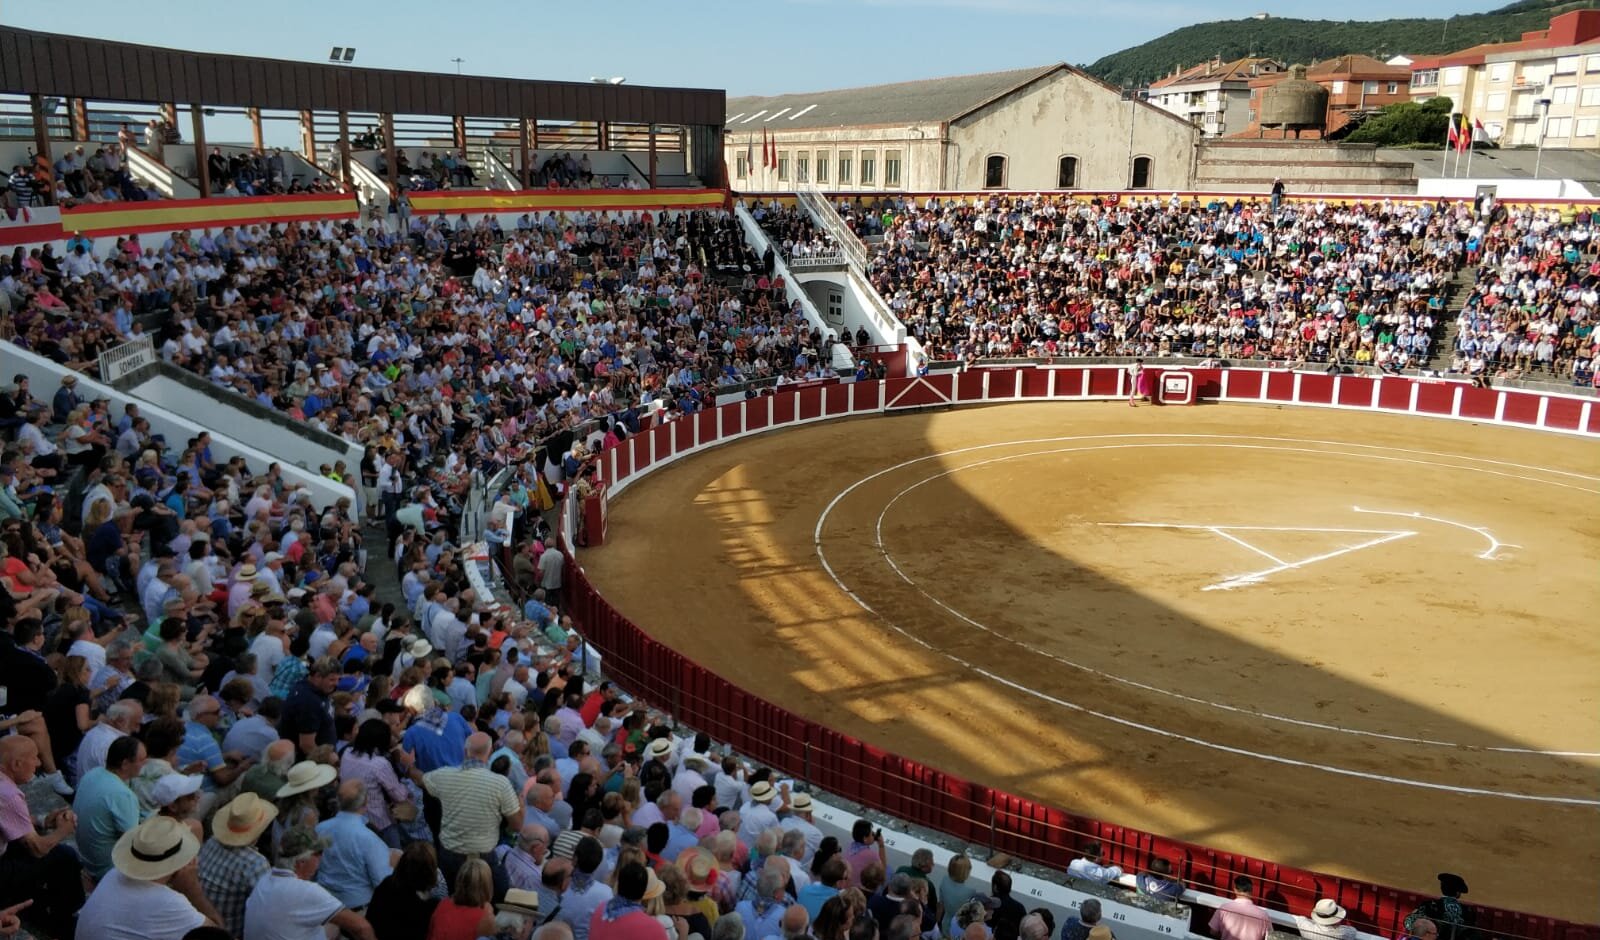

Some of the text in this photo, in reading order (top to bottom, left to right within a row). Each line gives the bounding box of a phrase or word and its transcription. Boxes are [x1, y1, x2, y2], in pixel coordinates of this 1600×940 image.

[815, 257, 843, 265] PRINCIPAL
[119, 354, 145, 375] SOMBRA
[1158, 924, 1171, 933] 89
